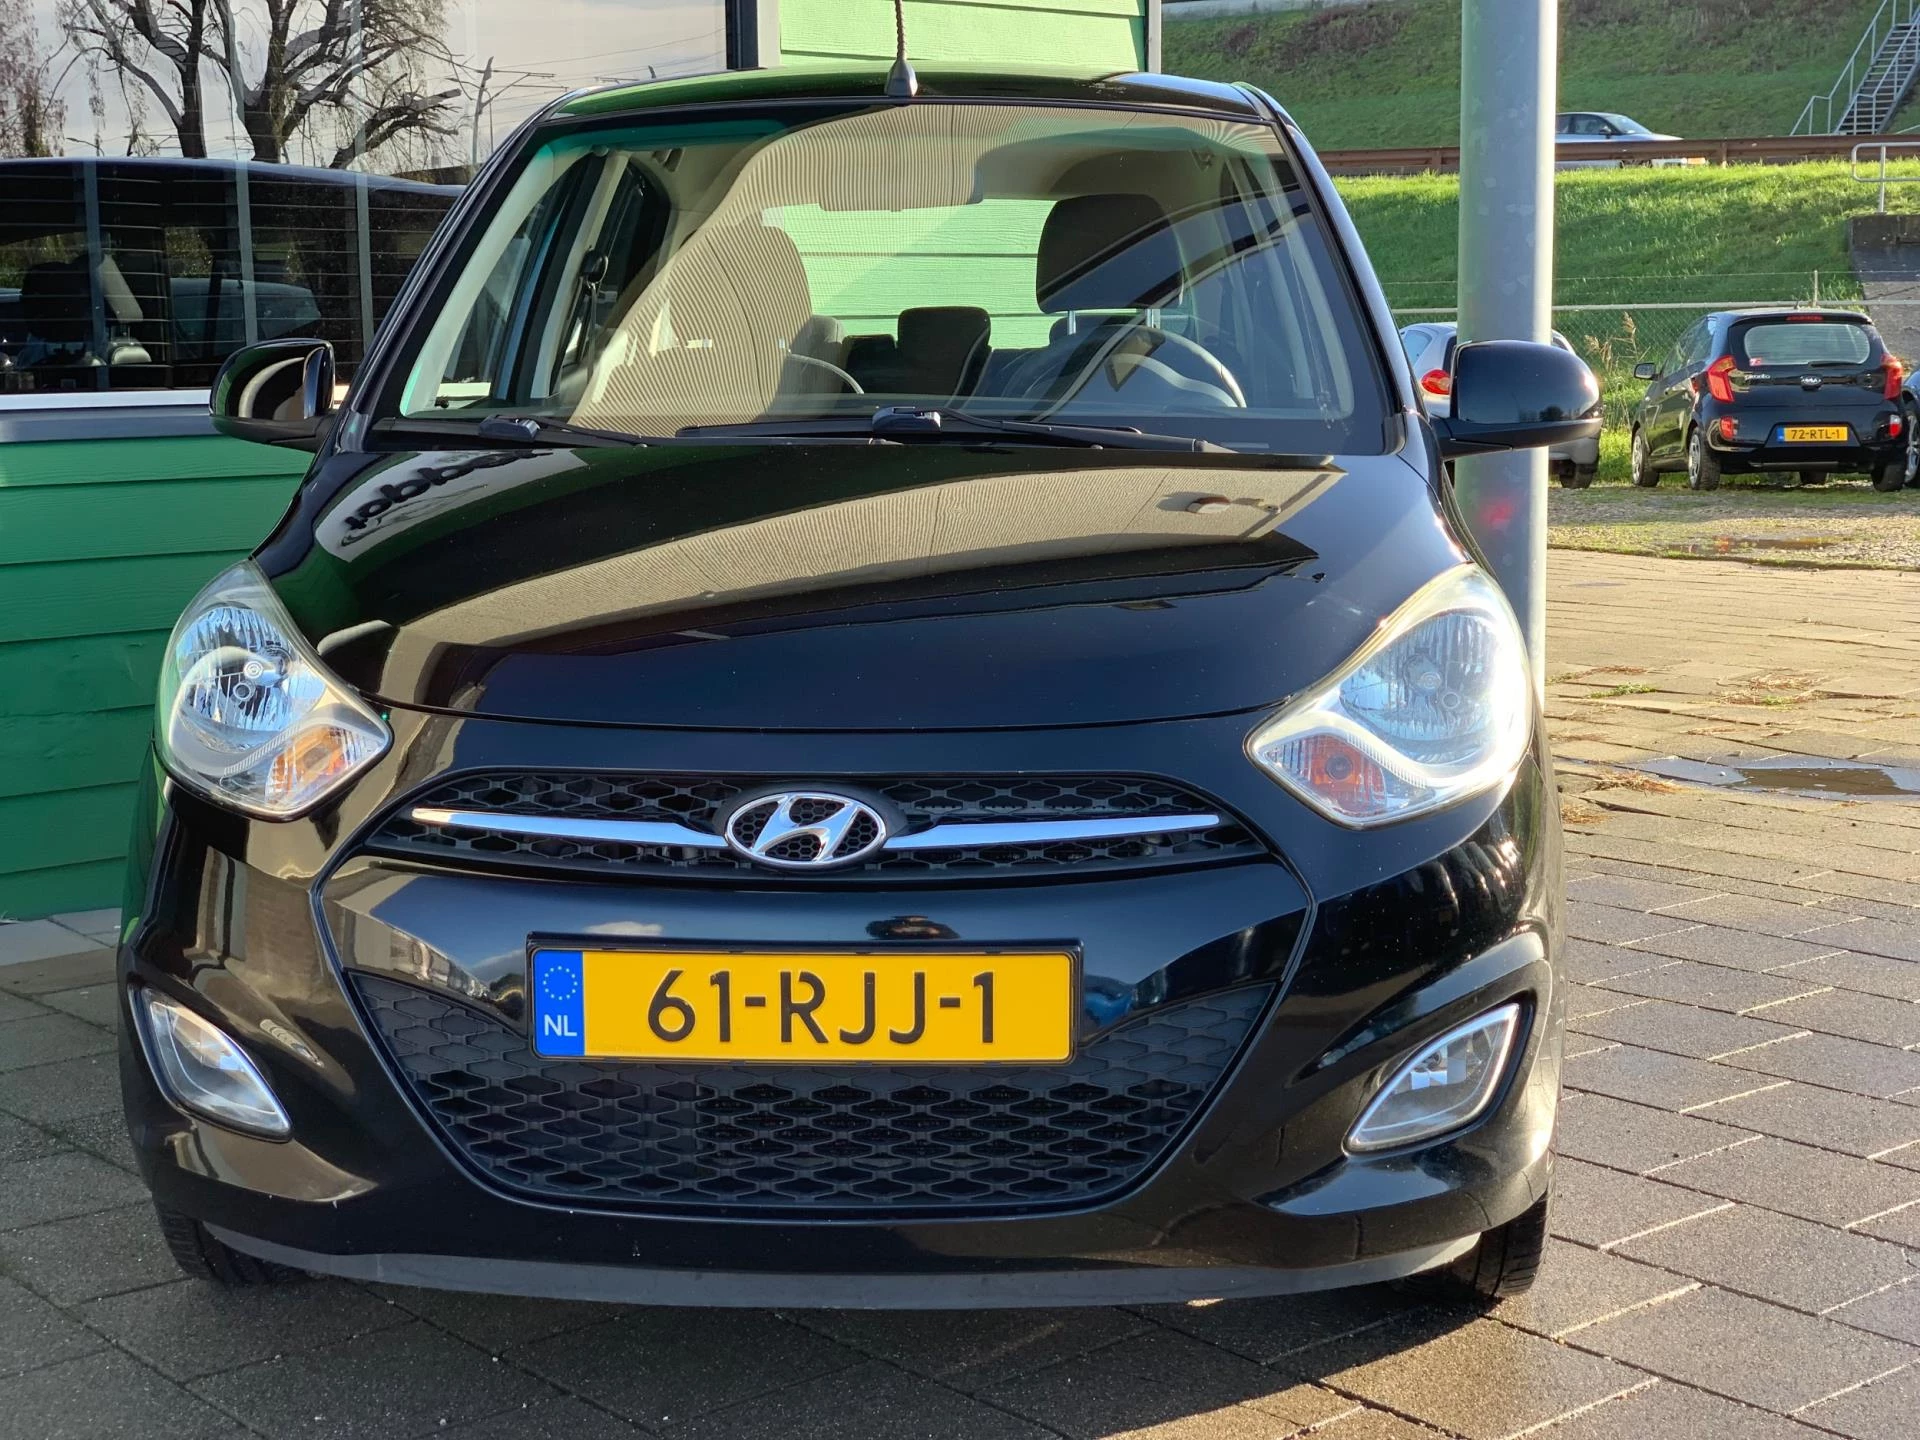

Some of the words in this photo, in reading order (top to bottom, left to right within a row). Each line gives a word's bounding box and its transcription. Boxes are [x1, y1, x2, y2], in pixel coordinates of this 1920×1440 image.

[1790, 429, 1840, 440] 72-RTL-1
[647, 969, 994, 1044] 61-RJJ-1
[543, 1015, 577, 1037] NL
